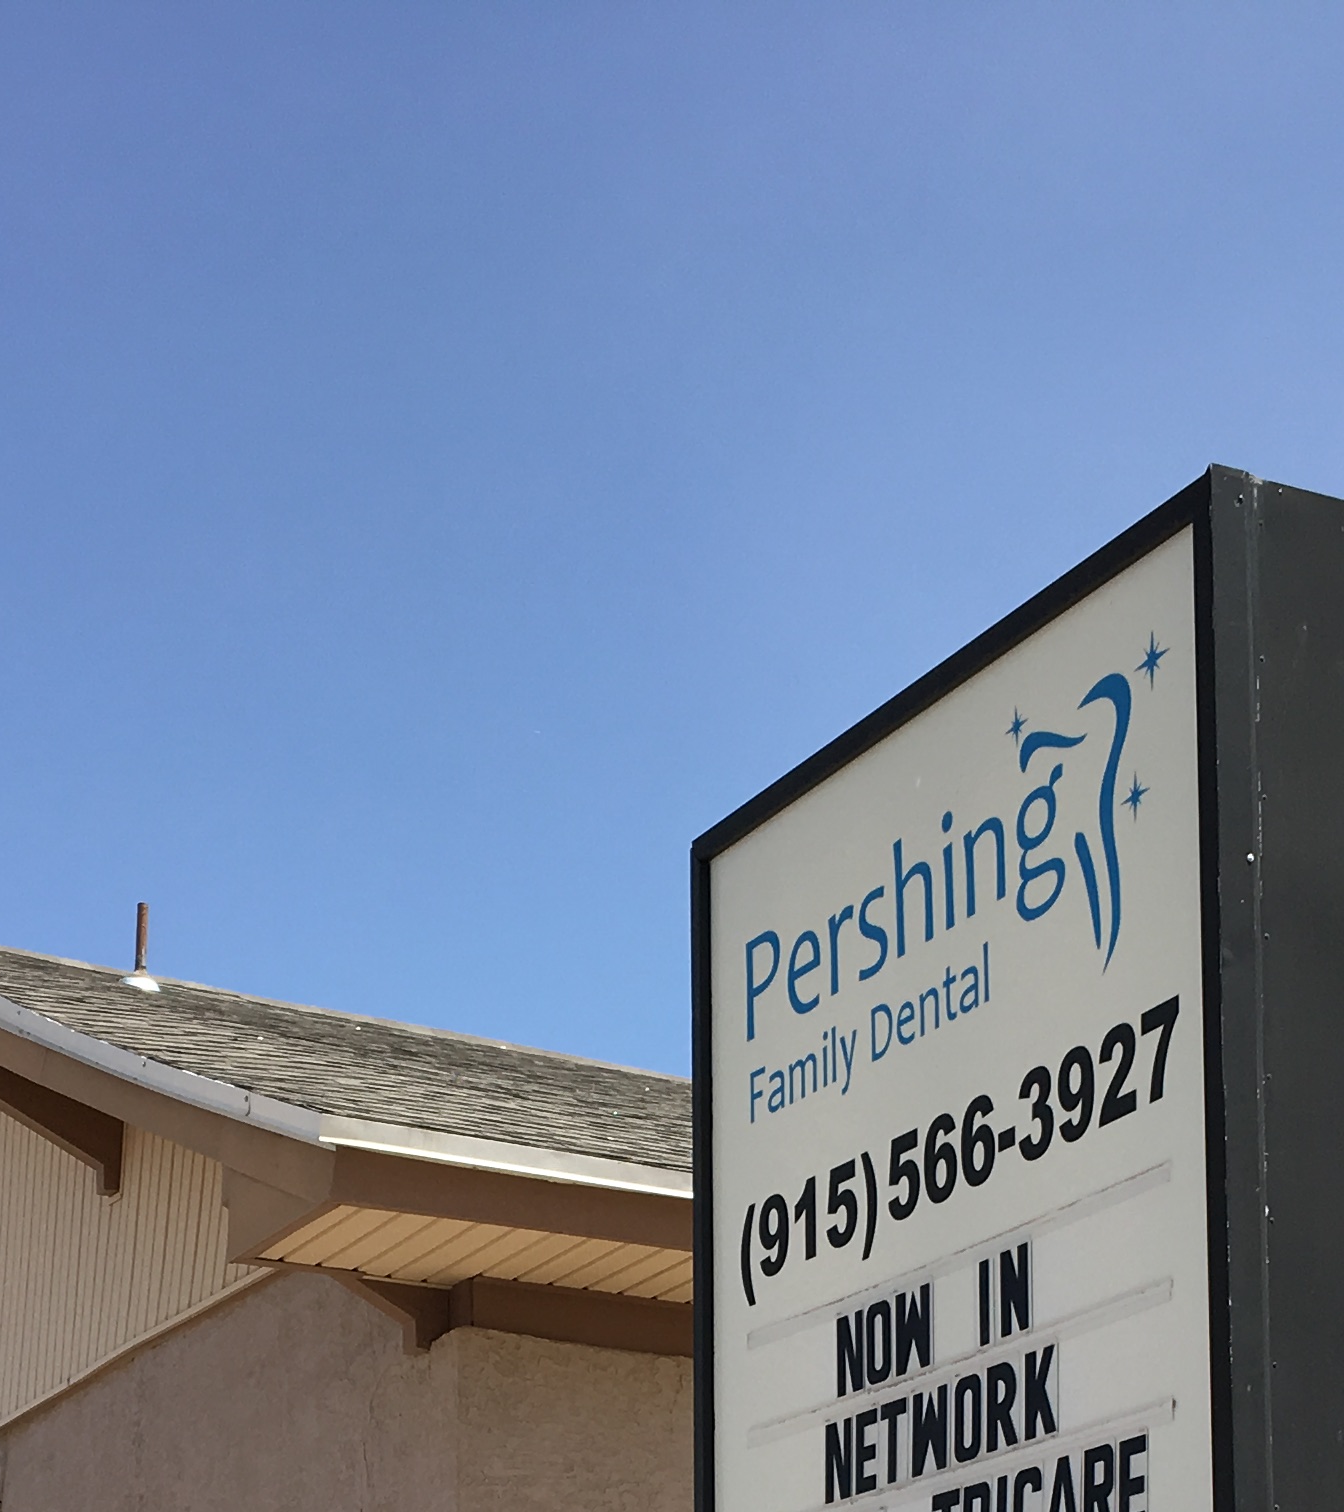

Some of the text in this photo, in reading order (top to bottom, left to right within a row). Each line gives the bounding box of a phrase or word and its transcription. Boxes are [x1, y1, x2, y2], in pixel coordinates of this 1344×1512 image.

[745, 764, 1066, 1042] Pershing
[750, 943, 990, 1124] Family Dental
[837, 1242, 1030, 1398] NOW IN
[824, 1345, 1057, 1505] NETWORK
